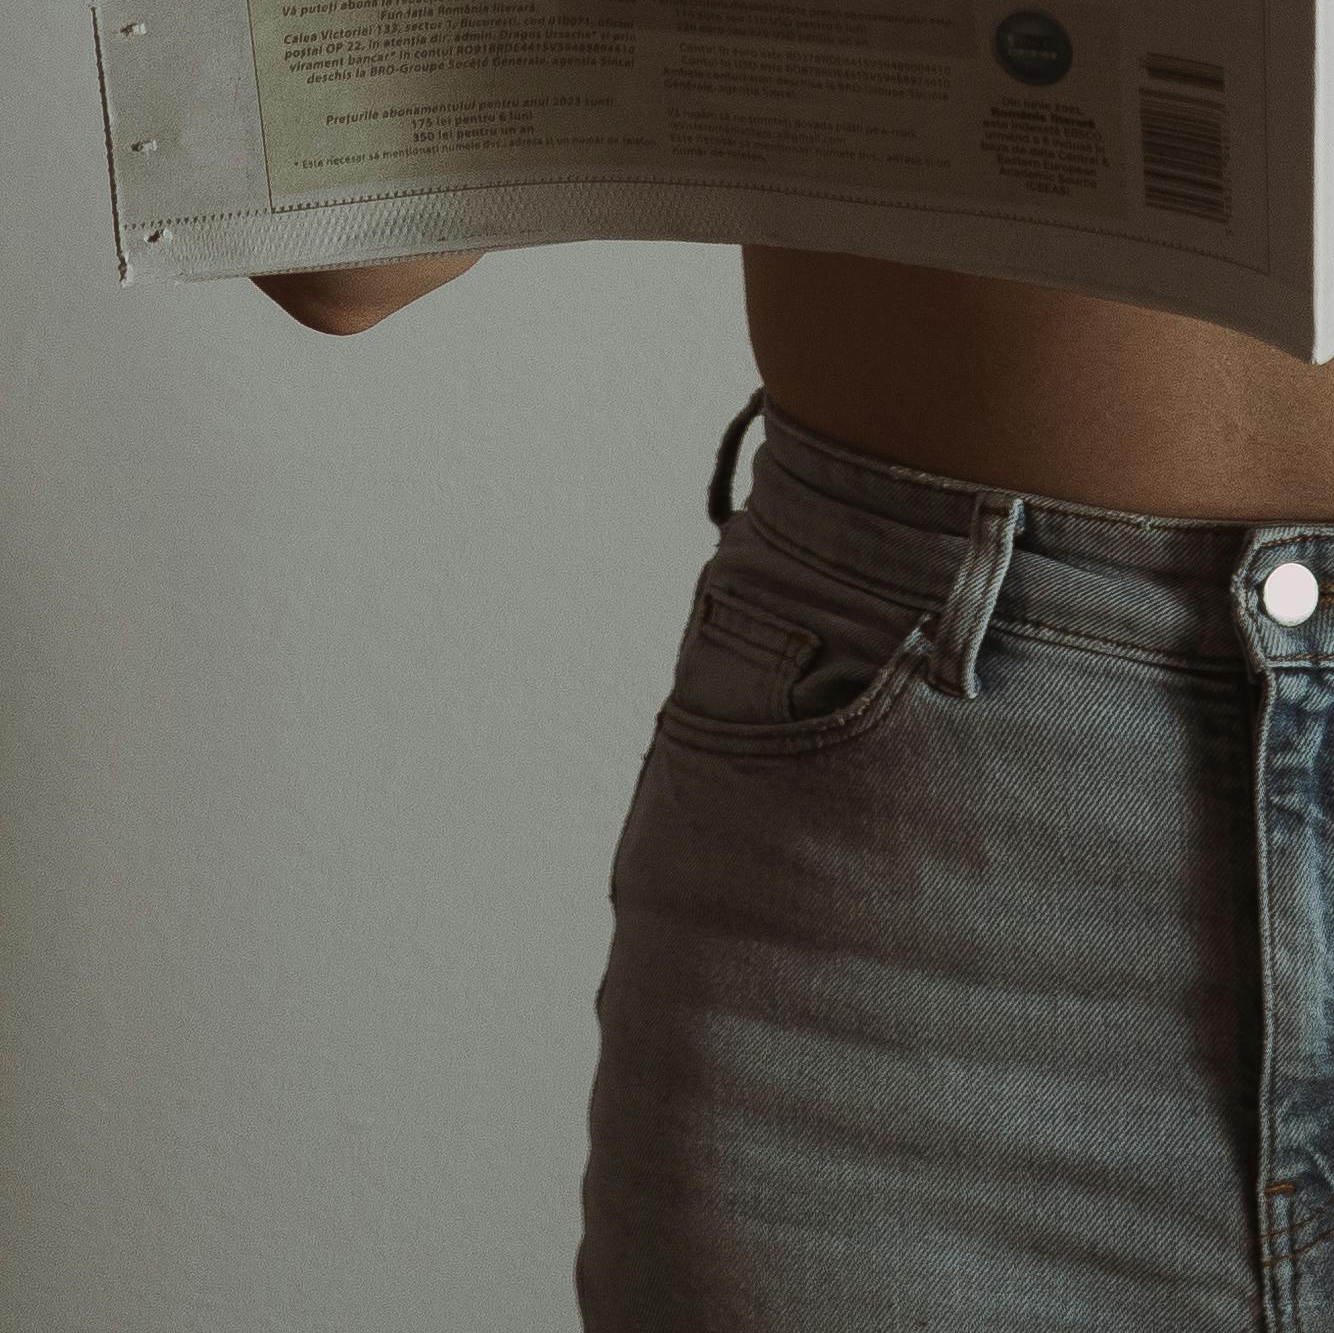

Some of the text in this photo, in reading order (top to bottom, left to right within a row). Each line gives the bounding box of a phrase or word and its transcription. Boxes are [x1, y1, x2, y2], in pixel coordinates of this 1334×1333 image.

[479, 98, 520, 111] pentru
[524, 96, 549, 108] anul
[412, 119, 433, 130] 175
[436, 115, 452, 127] lei
[455, 112, 496, 127] pentru
[510, 110, 533, 122] luni
[413, 124, 535, 143] 350 lei pentru un an
